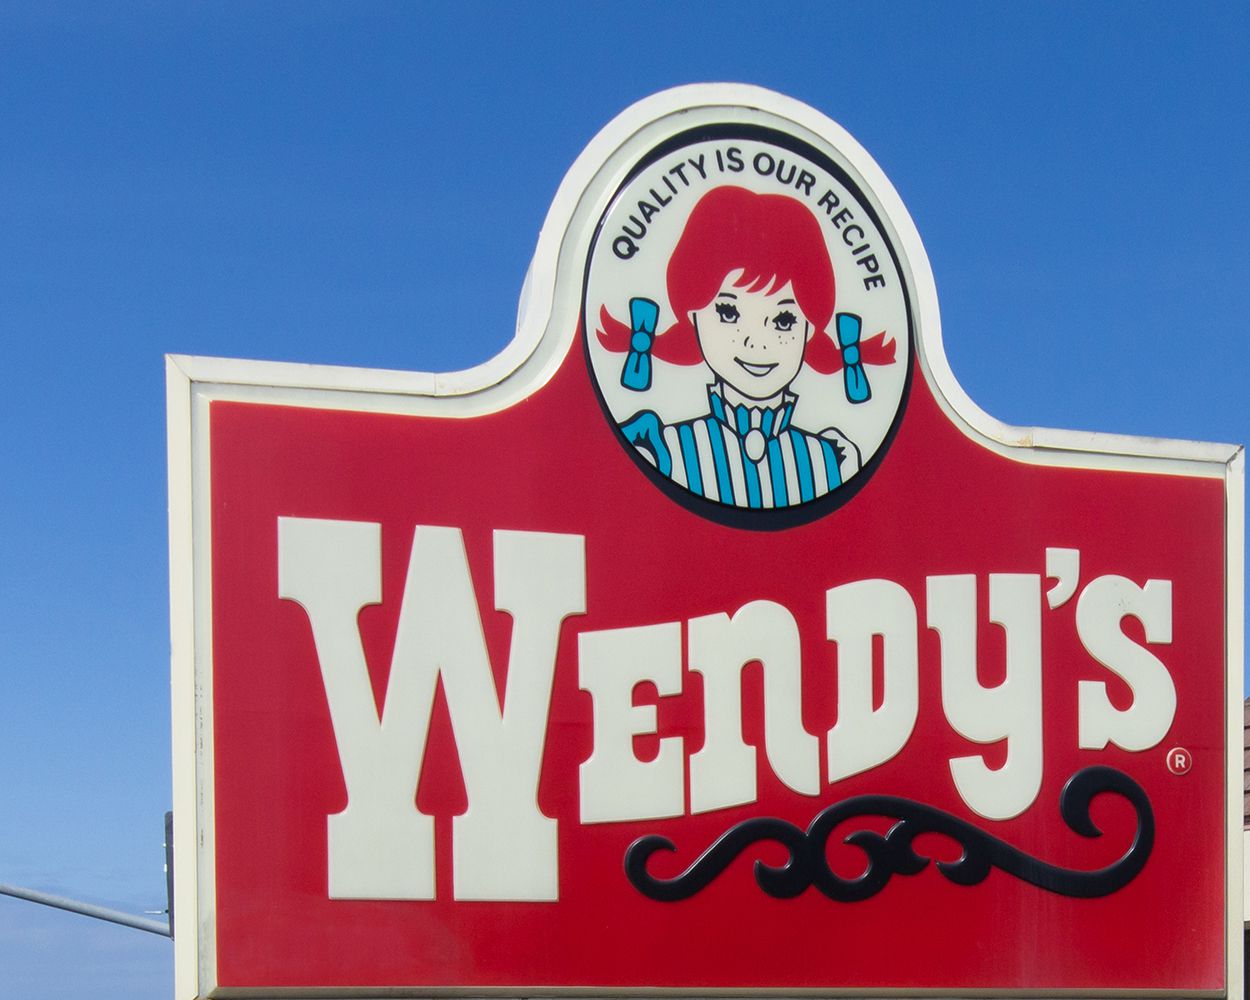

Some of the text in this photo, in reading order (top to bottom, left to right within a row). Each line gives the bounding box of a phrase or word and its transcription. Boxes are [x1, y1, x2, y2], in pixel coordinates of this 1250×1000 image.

[612, 147, 885, 291] QUALITY IS OUR RECIPE
